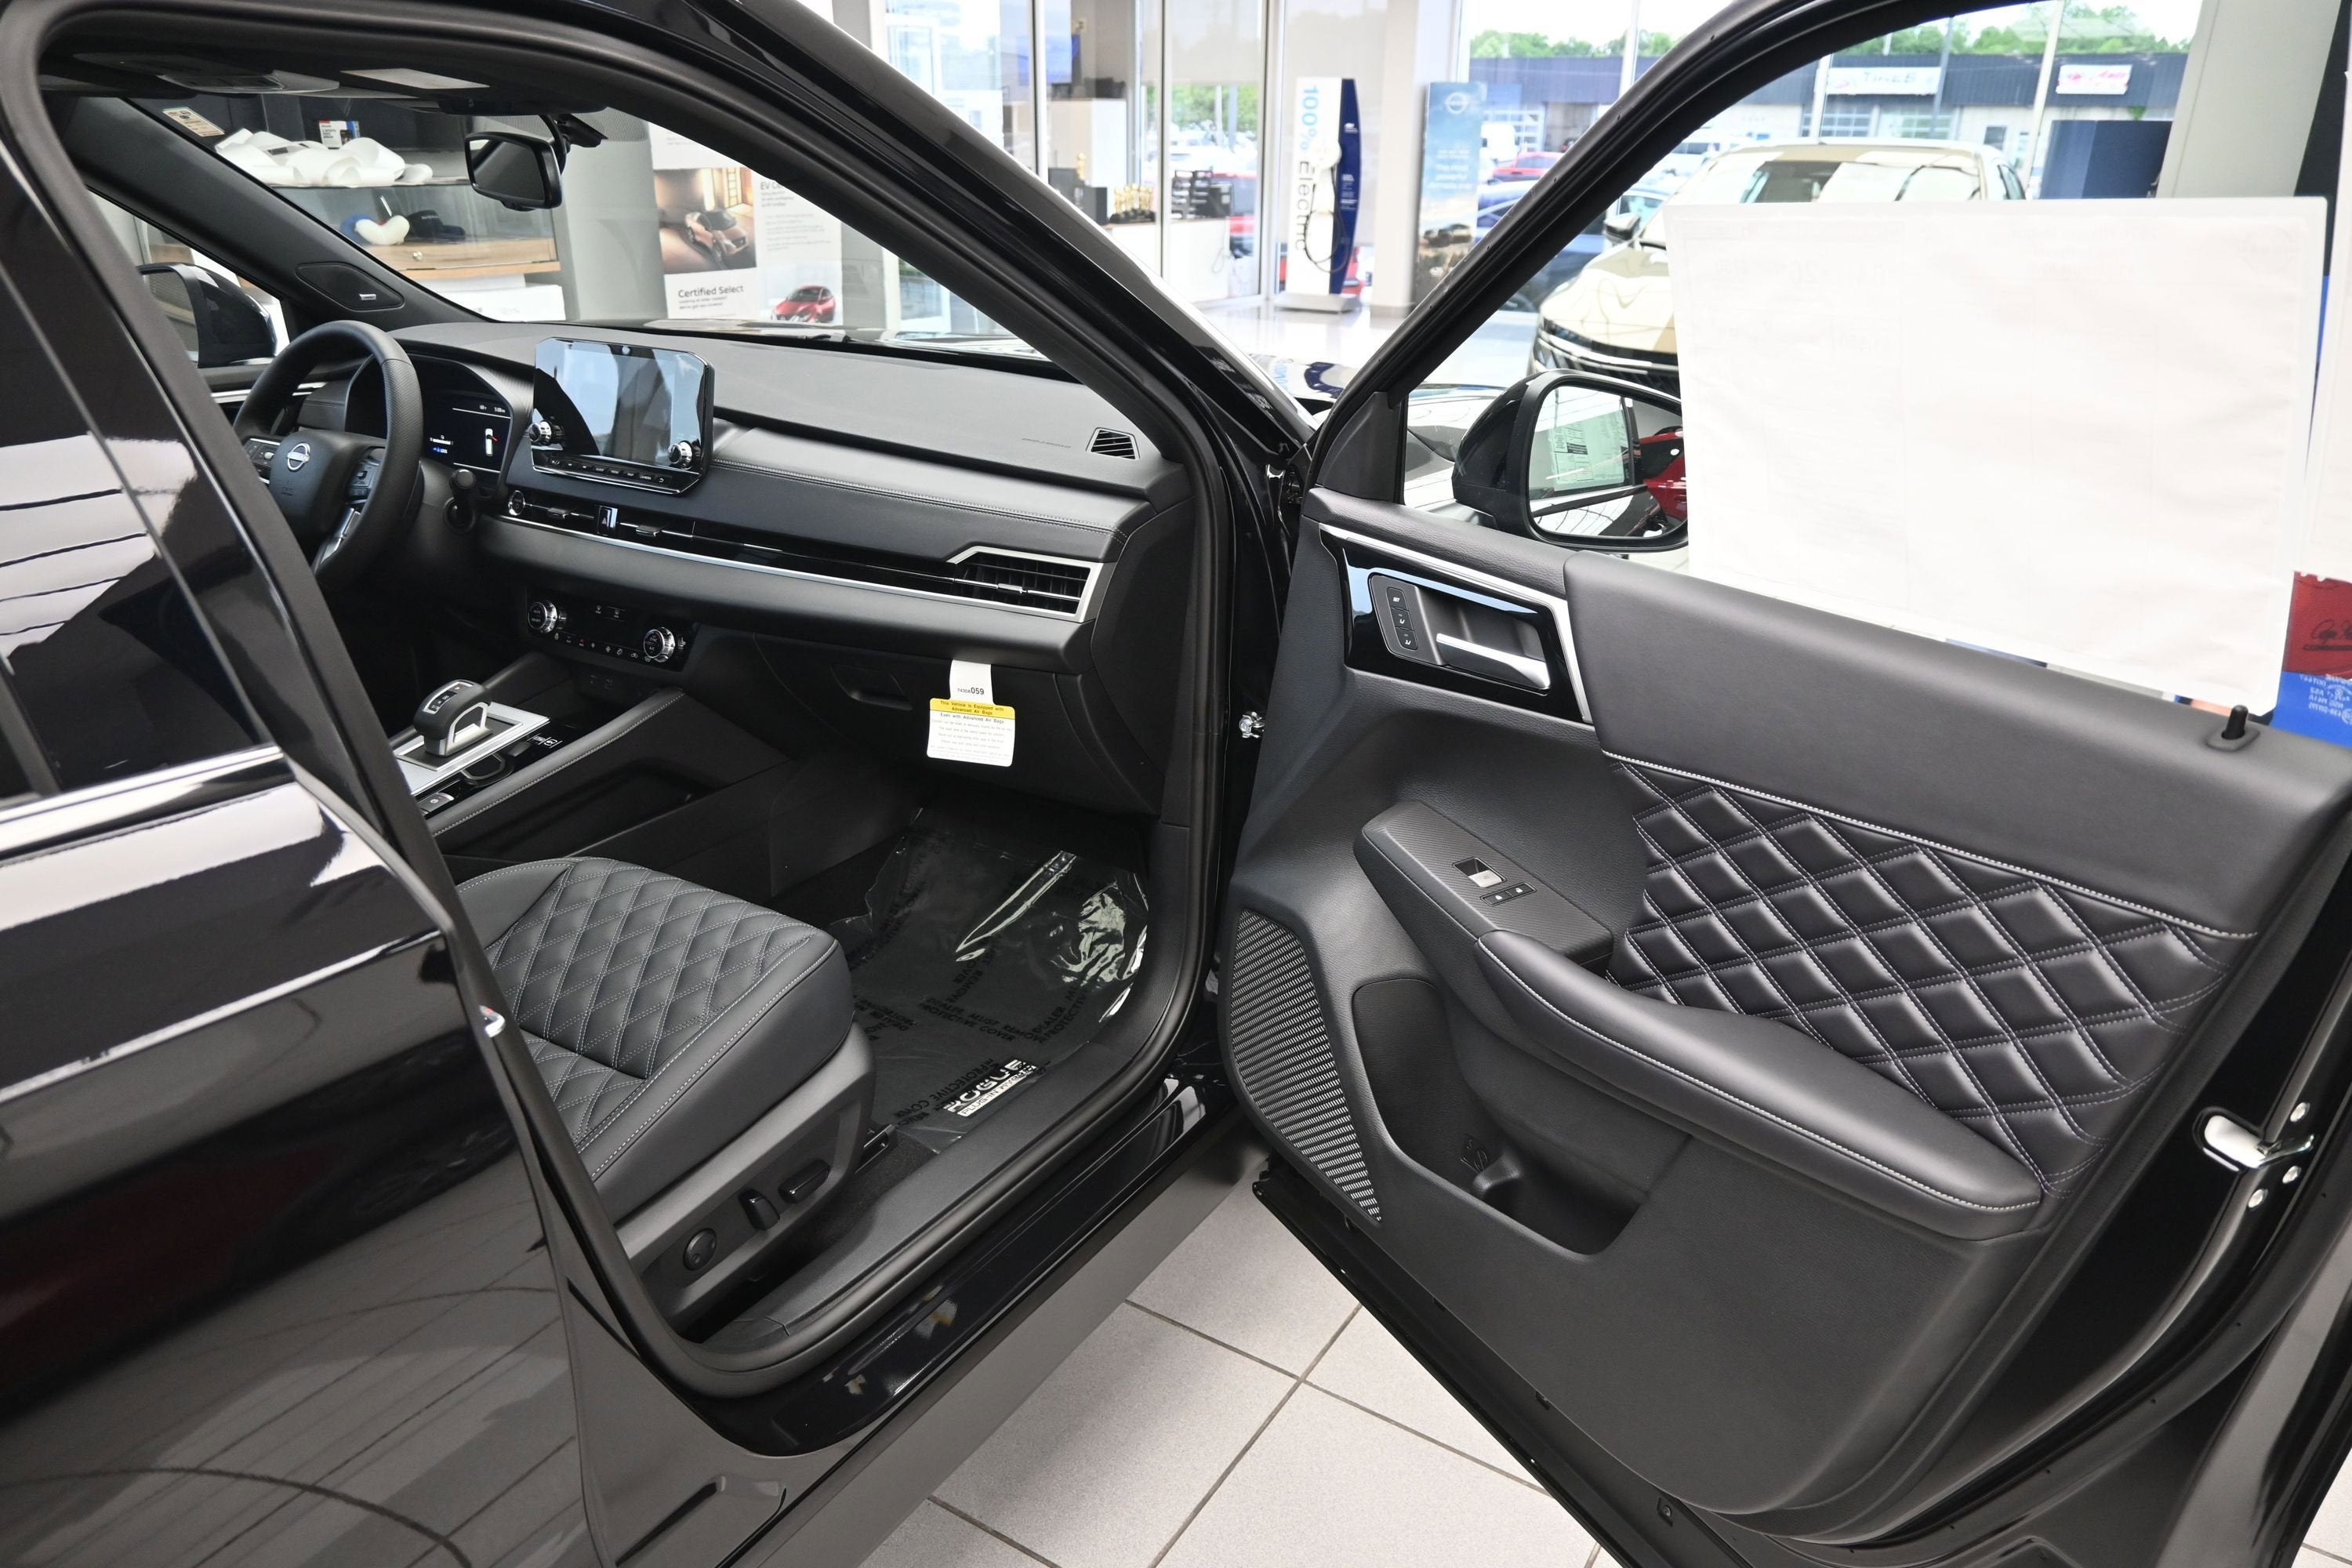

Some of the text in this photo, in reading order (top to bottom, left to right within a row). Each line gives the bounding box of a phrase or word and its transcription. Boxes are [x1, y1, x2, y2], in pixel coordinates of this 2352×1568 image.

[1301, 85, 1319, 151] 100%
[678, 285, 744, 298] Certified Select
[968, 1012, 1000, 1026] MUST
[1033, 1006, 1065, 1033] DEALER
[979, 1025, 1017, 1042] COVER
[943, 1059, 1027, 1113] ROGUE
[893, 1099, 930, 1119] COVER
[961, 1088, 1000, 1115] PLUG-IN
